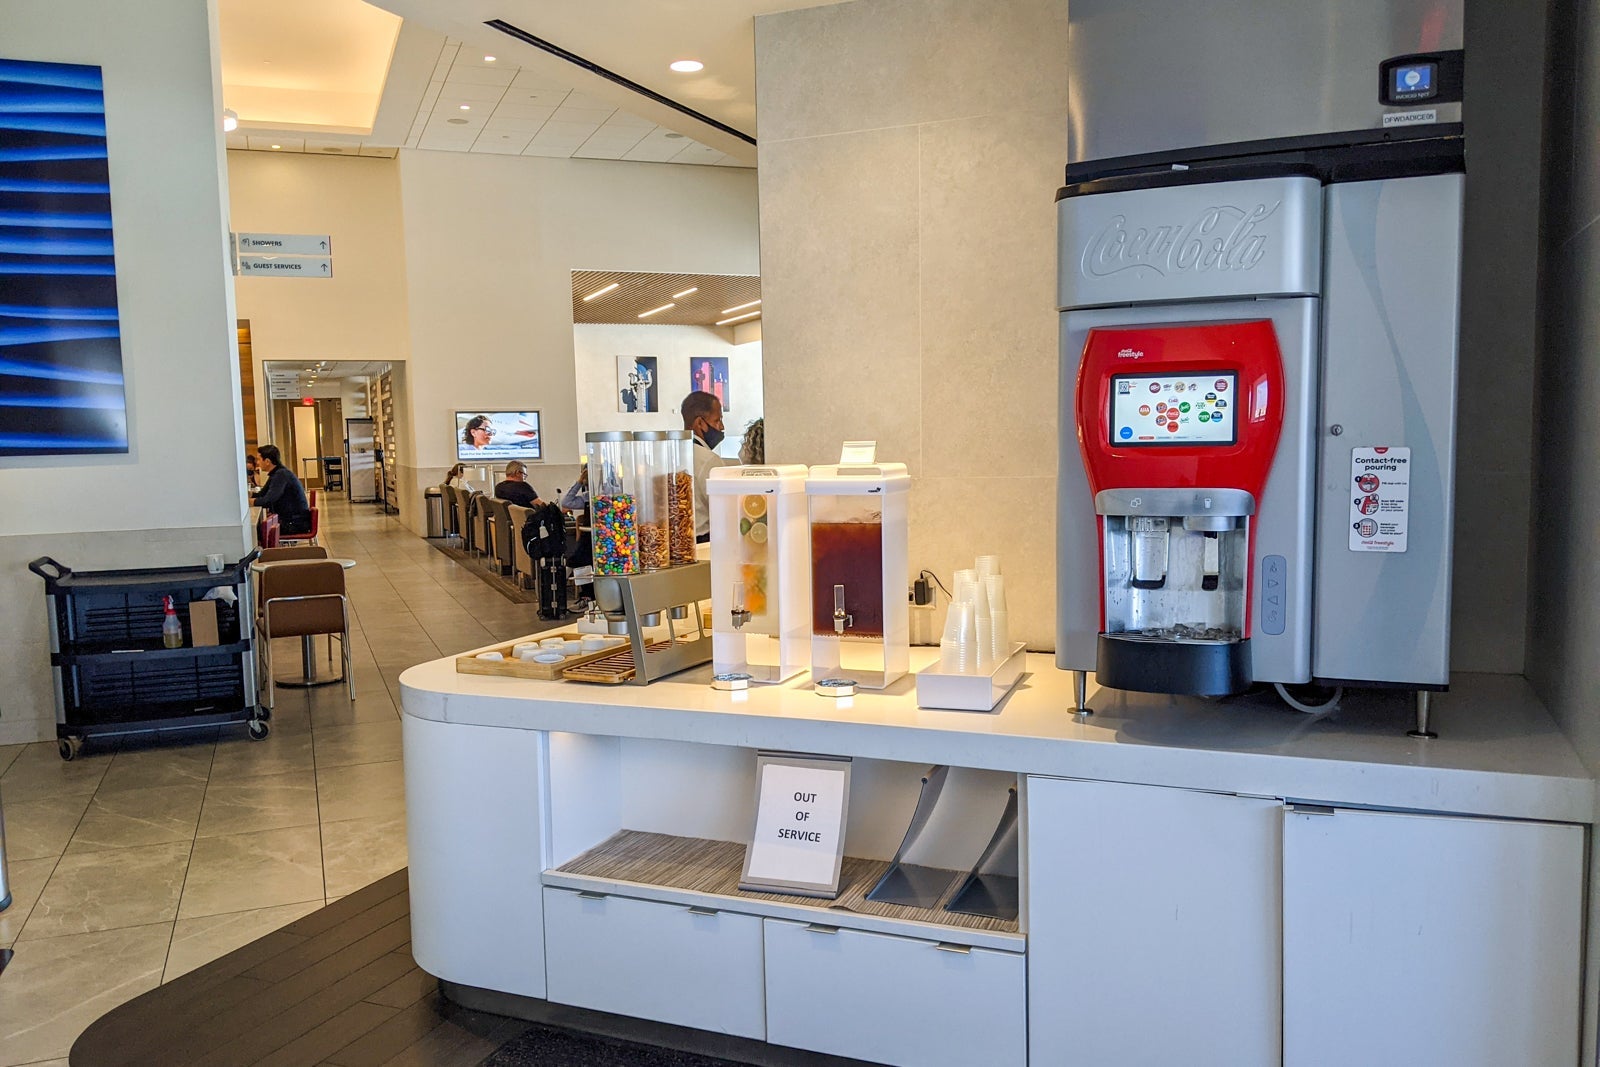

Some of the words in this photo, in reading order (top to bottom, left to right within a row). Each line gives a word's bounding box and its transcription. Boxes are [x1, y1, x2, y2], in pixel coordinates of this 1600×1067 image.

[1080, 200, 1281, 280] Coca-Cola
[793, 792, 817, 803] OUT
[795, 811, 810, 822] OF
[778, 828, 822, 842] SERVICE
